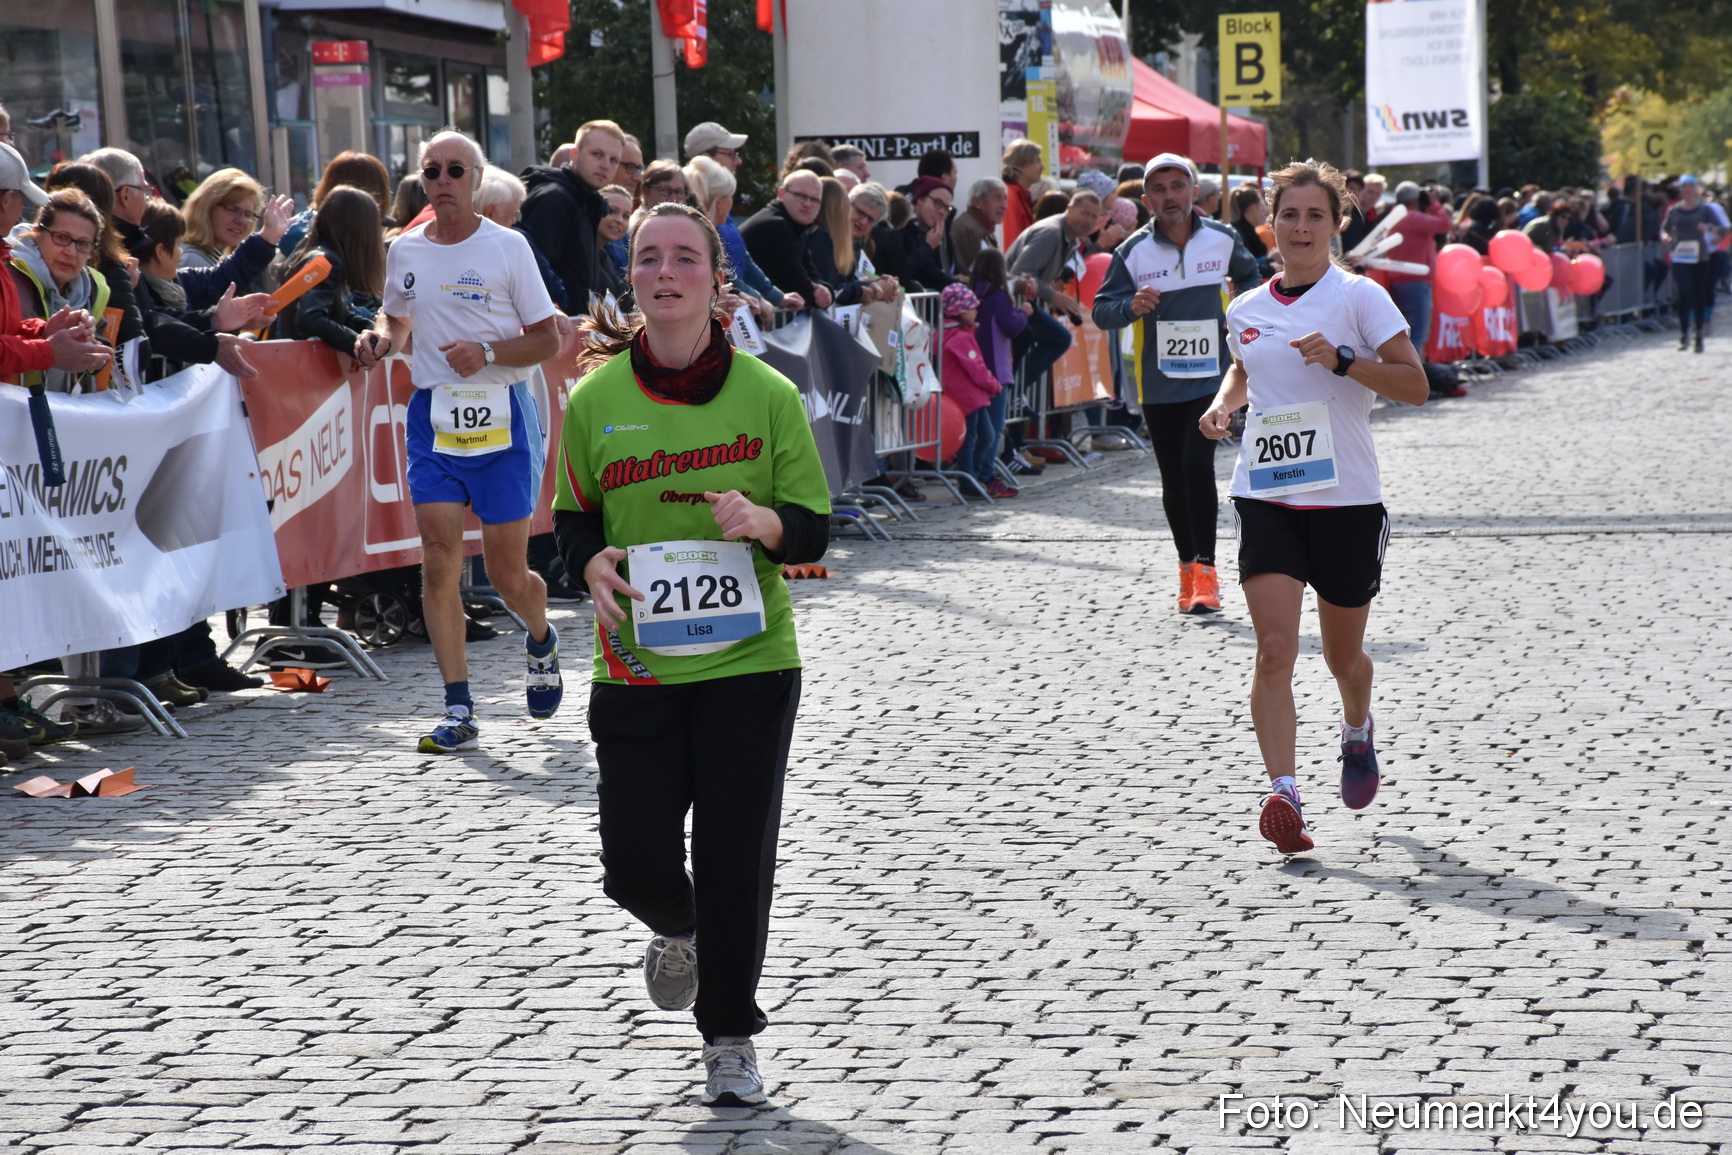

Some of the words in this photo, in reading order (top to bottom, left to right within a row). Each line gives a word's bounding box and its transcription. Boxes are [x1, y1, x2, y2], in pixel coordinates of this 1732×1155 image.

[1226, 17, 1272, 35] Block
[1236, 43, 1265, 85] B
[1646, 133, 1664, 158] C
[1166, 338, 1210, 356] 2210
[450, 407, 492, 429] 192
[1269, 412, 1301, 423] BOCK
[47, 428, 58, 460] HYUNDAI
[311, 407, 347, 487] NEUE
[456, 434, 488, 444] Hartmut
[1256, 429, 1317, 463] 2607
[600, 433, 764, 493] Alfafreunde
[1273, 468, 1306, 481] Kerstin
[677, 551, 718, 562] BOCK
[650, 575, 743, 615] 2128
[687, 624, 713, 637] Lisa
